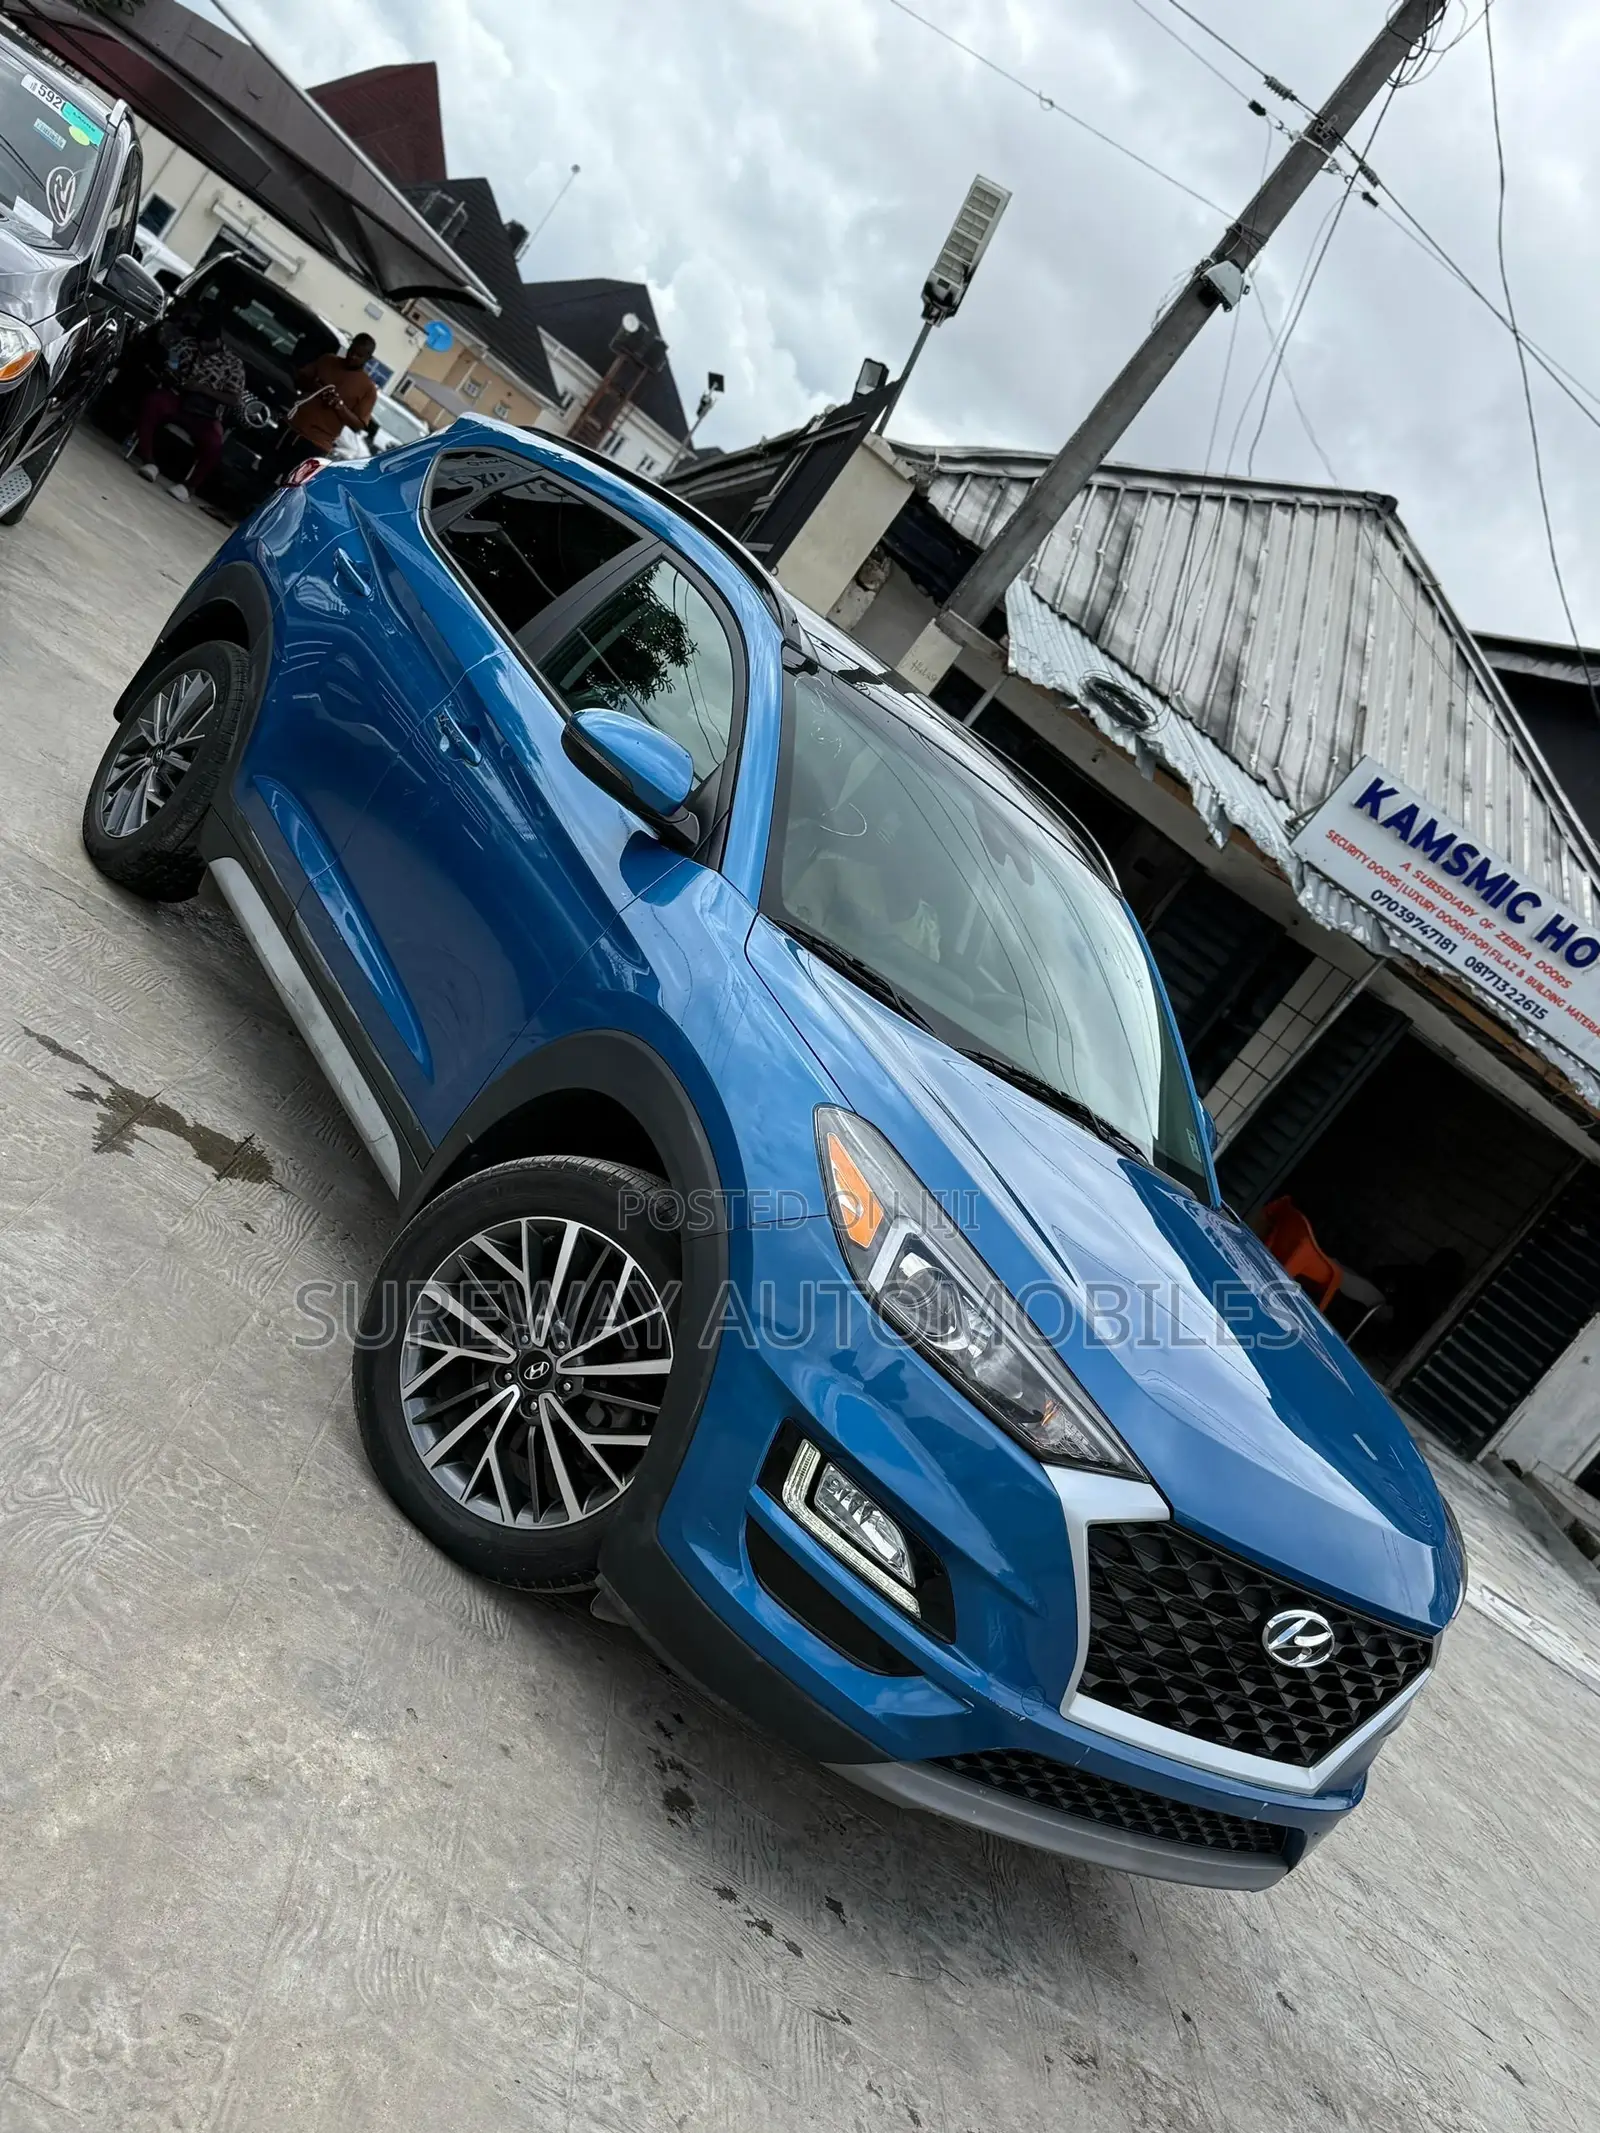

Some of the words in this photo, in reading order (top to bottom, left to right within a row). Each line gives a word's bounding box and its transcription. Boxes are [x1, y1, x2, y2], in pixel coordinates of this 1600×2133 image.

[38, 84, 63, 110] 592
[1325, 829, 1371, 864] SECURITY
[1516, 969, 1526, 979] &
[1524, 976, 1567, 1008] BUILDING
[1354, 777, 1542, 924] KAMSMIC
[1534, 913, 1600, 968] HO
[1399, 862, 1412, 872] A
[1412, 870, 1478, 917] SUBSIDIARY
[1479, 918, 1496, 930] OF
[1494, 930, 1533, 960] ZEBRA
[1535, 960, 1573, 989] DOORS
[1371, 889, 1458, 955] 07039747181
[1464, 956, 1548, 1020] 08171322615
